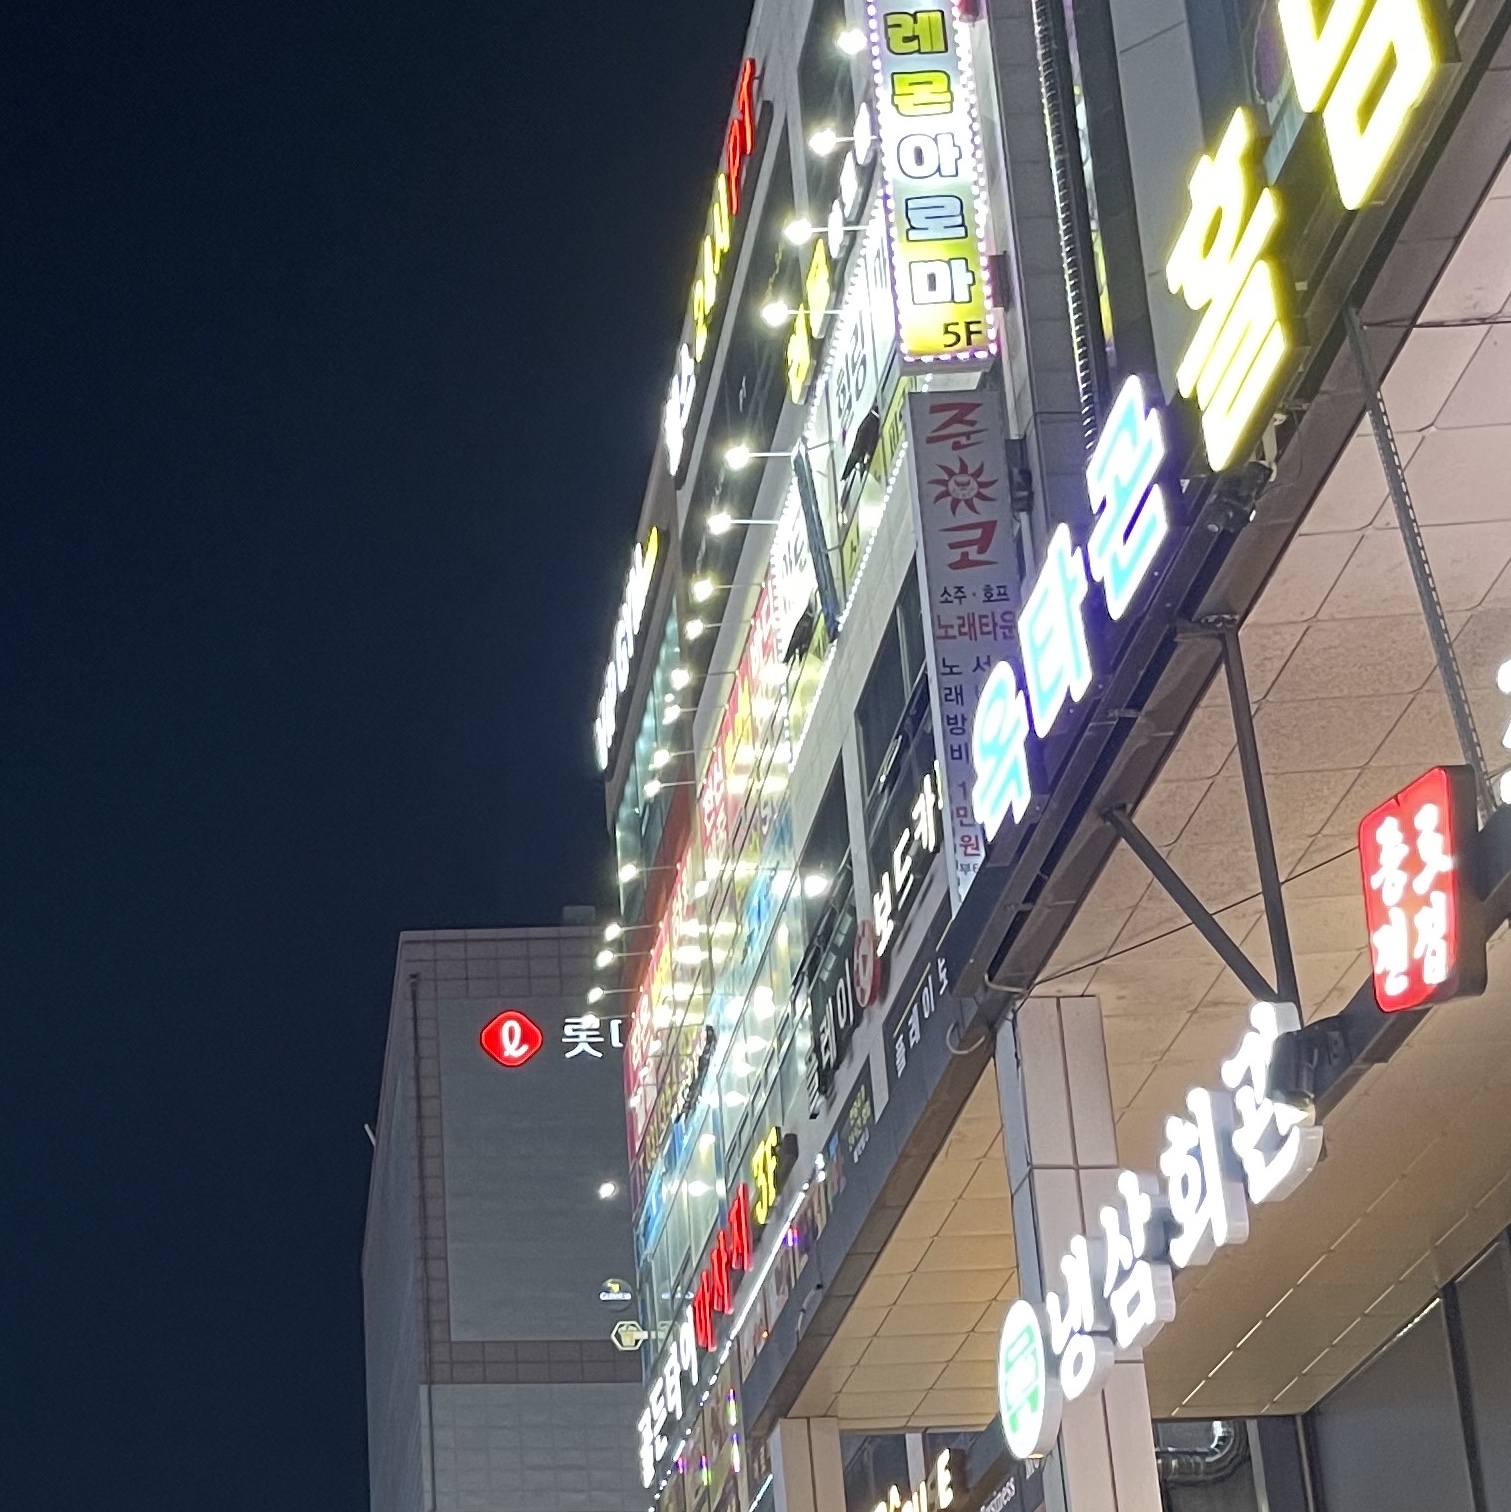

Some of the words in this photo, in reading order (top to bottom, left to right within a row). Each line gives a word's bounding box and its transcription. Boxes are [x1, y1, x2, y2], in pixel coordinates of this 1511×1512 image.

[883, 10, 976, 306] 레몬아로마
[941, 320, 982, 349] 5F
[939, 585, 967, 605] 소주
[982, 584, 1011, 604] 호프
[935, 610, 1016, 642] 노래타운
[873, 758, 943, 958] 보드카
